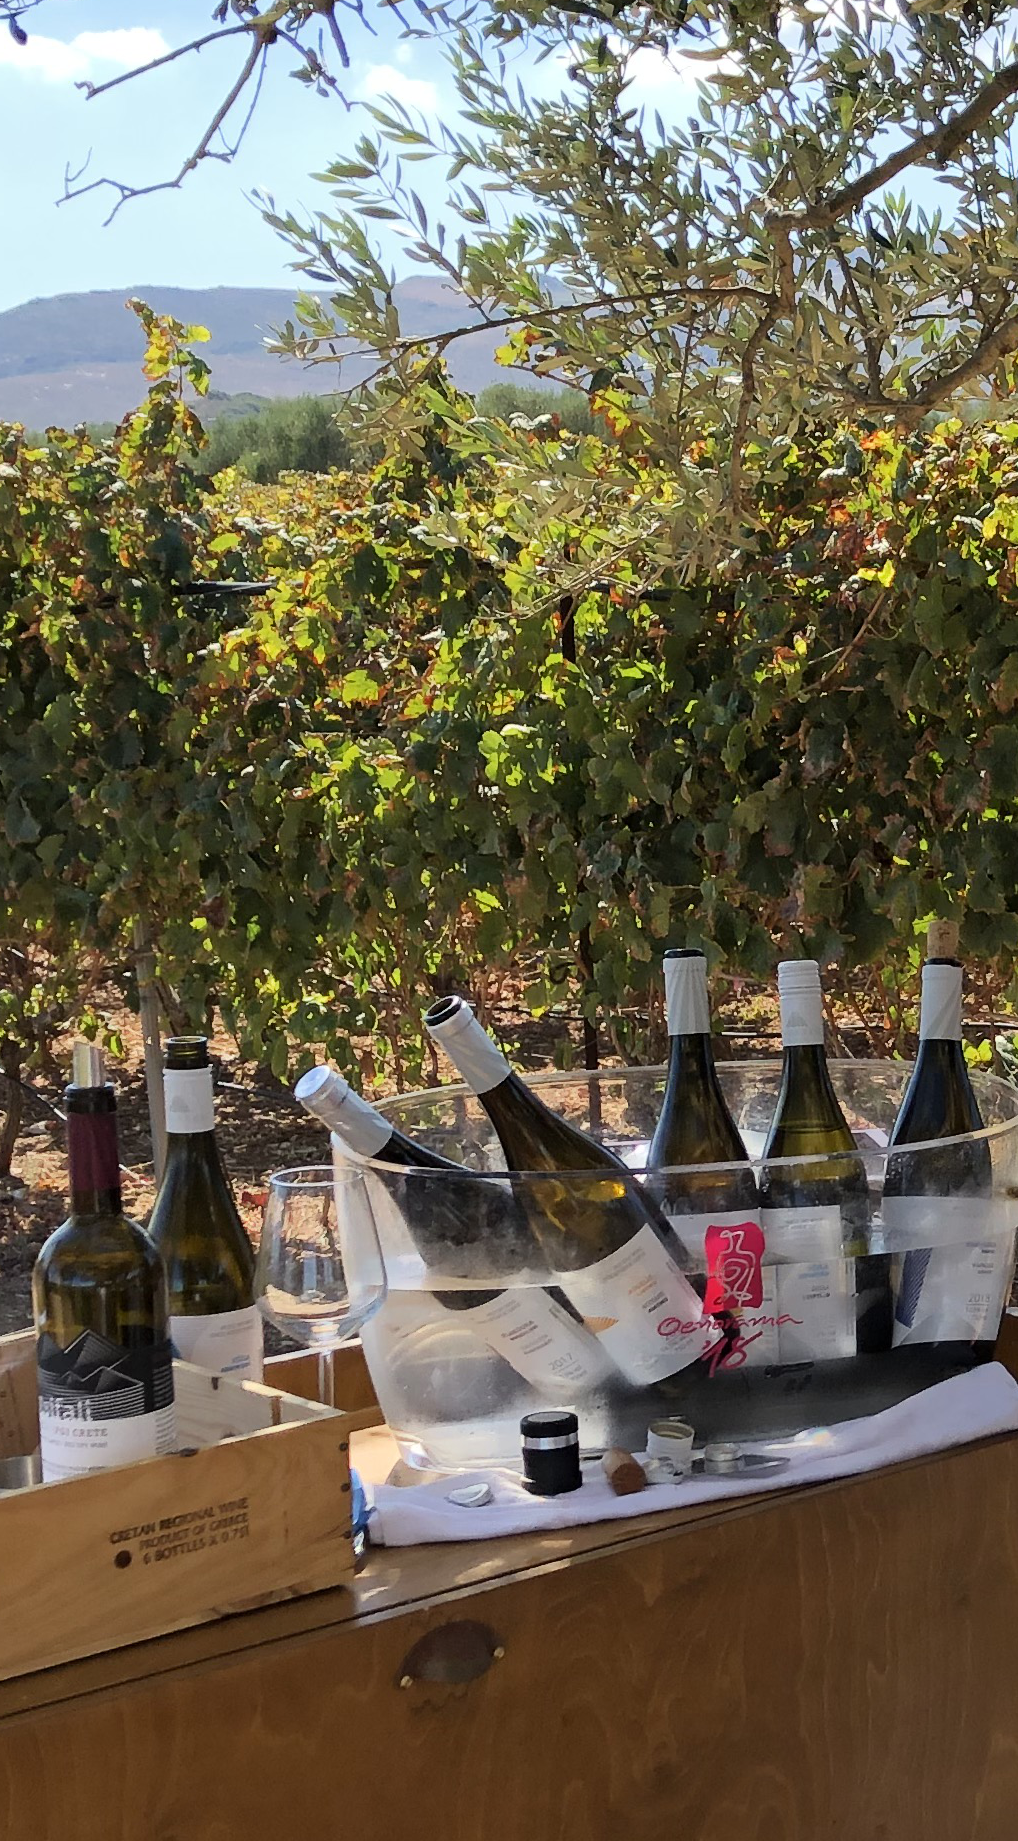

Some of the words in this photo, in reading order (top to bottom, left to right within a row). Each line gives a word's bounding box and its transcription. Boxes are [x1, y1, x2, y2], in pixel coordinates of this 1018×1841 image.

[657, 1313, 804, 1337] Oenorama
[548, 1352, 574, 1371] 2017
[72, 1427, 109, 1438] CRETE
[110, 1522, 156, 1545] CRETAN
[159, 1506, 215, 1531] REGIONAL
[139, 1528, 190, 1550] PRODUCT
[193, 1523, 206, 1536] OF
[155, 1538, 205, 1561] BOTTLES
